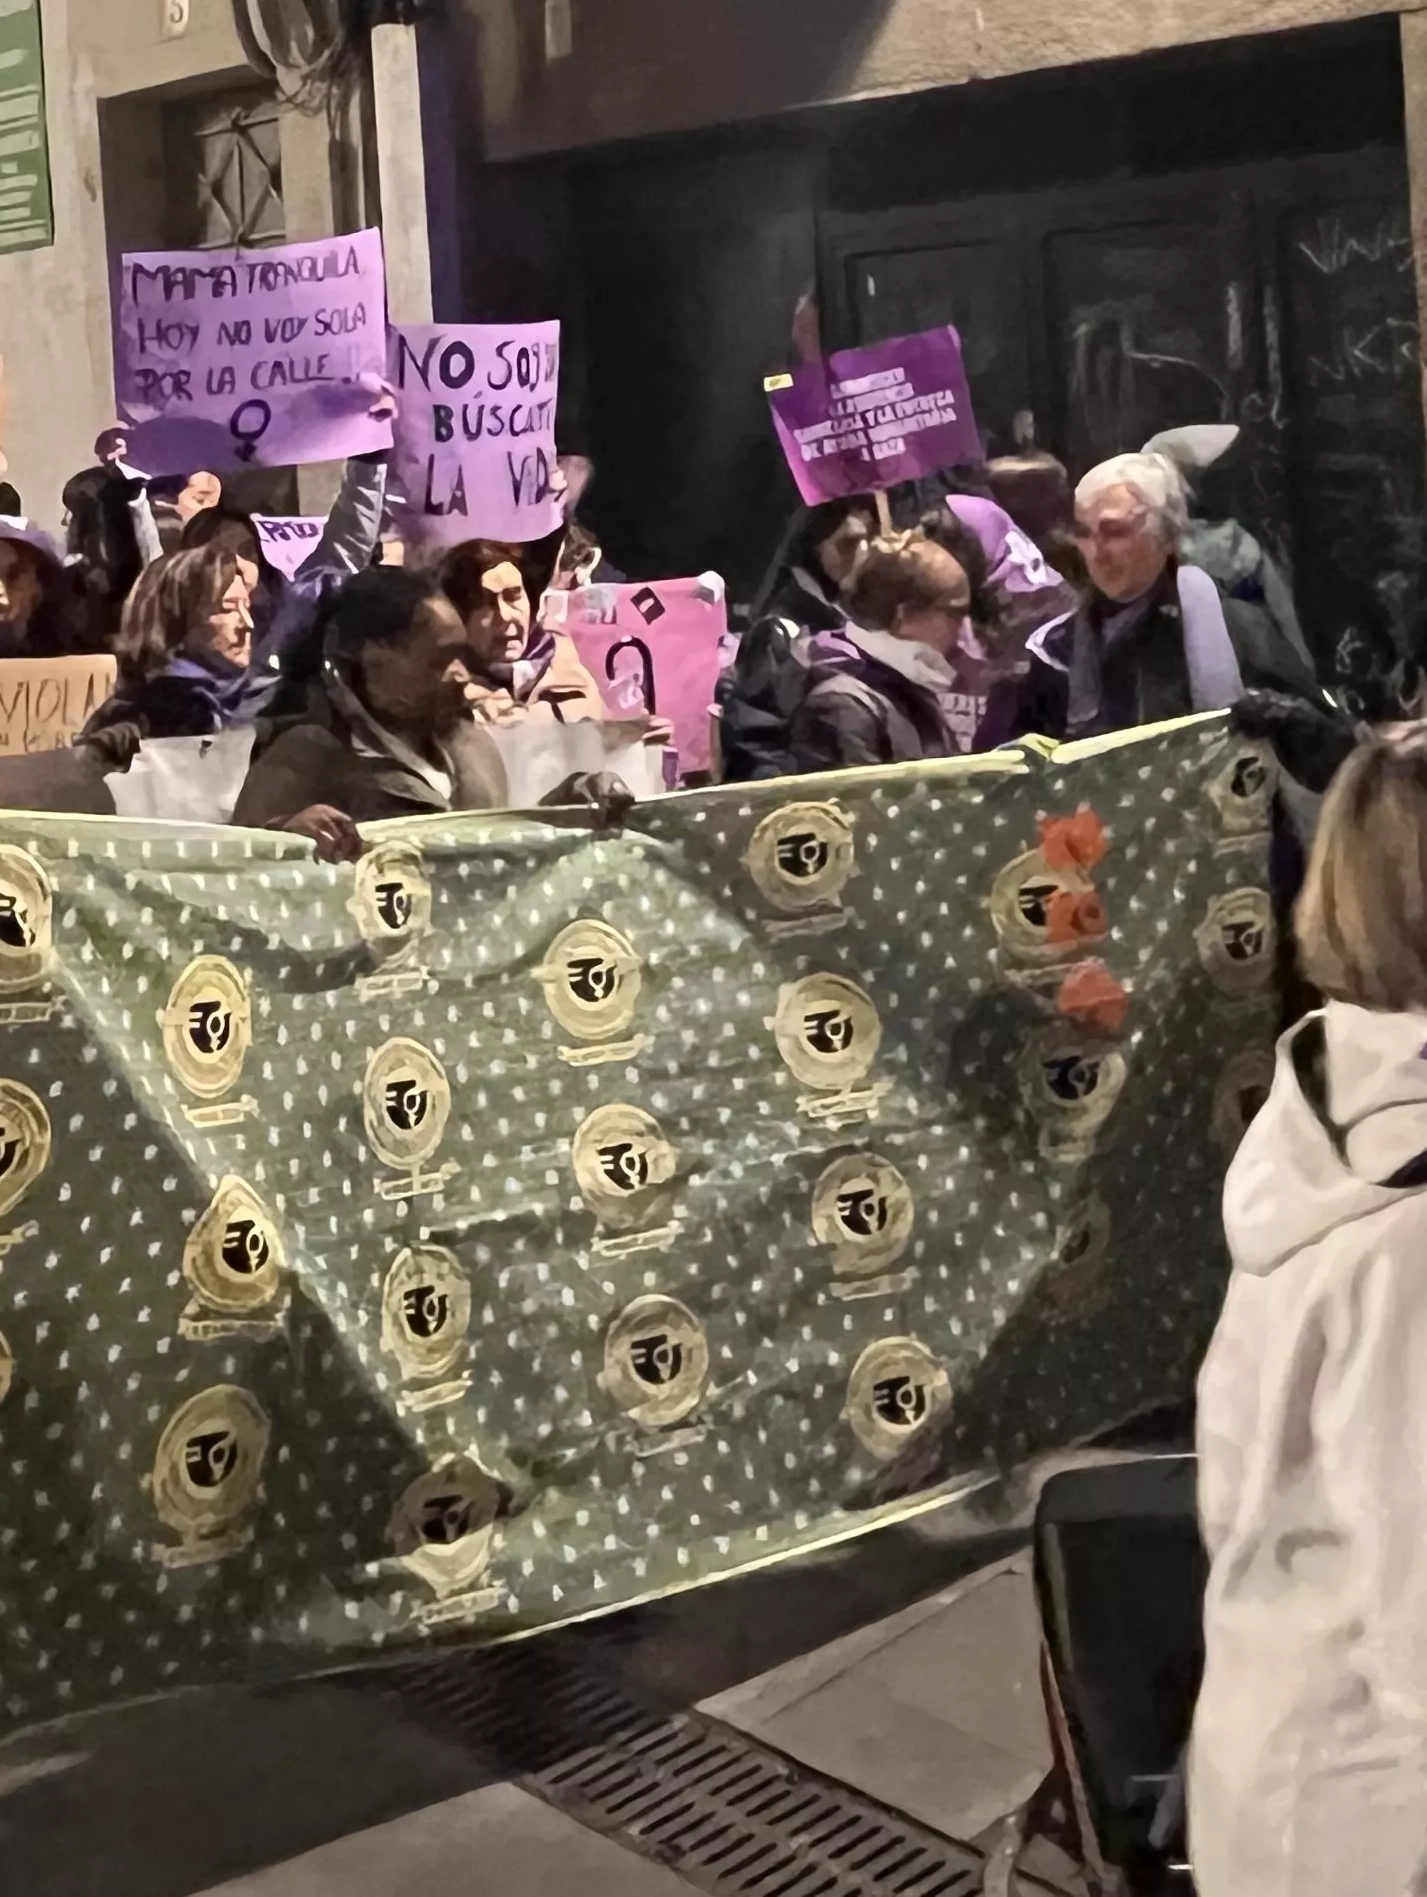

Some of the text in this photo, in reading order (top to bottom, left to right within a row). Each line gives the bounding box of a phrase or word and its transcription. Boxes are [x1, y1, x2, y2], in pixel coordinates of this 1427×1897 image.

[137, 302, 367, 354] HOY NO VOY SOLA
[135, 367, 194, 401] POR
[206, 366, 236, 395] LA
[398, 332, 475, 392] NO
[425, 453, 468, 517] LA
